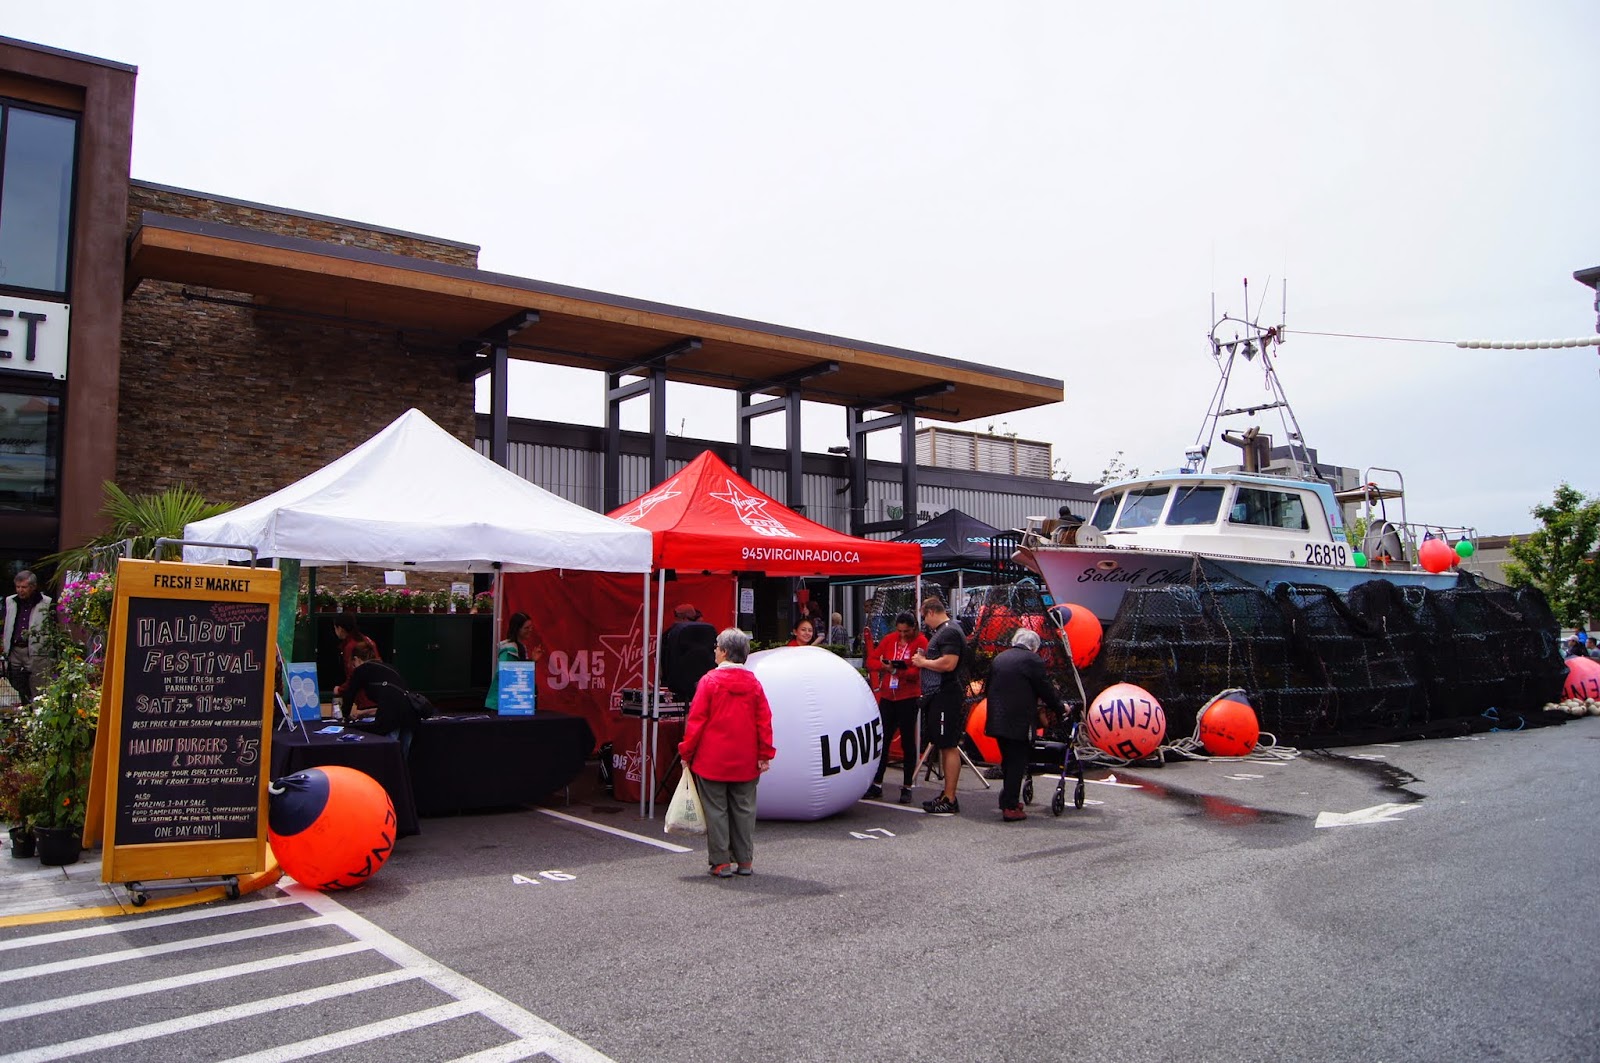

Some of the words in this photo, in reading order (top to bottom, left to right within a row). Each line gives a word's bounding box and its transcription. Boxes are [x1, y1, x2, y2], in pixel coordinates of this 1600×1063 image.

[742, 547, 859, 563] 945VIRGINRADIO.CA
[1305, 543, 1346, 566] 26819
[1077, 567, 1147, 583] Salish
[154, 574, 191, 589] FRESH
[195, 577, 204, 588] ST
[206, 578, 250, 592] MARKET
[164, 676, 172, 684] IN
[175, 676, 188, 684] THE
[191, 675, 215, 684] FRESH
[592, 677, 605, 689] FM
[165, 685, 198, 693] PARKING
[138, 695, 174, 713] SAT
[132, 720, 147, 729] BEST
[150, 720, 168, 728] PRICE
[170, 720, 178, 728] OF
[191, 719, 213, 727] SEASON
[130, 738, 174, 755] HALIBUT
[177, 738, 228, 753] BURGERS
[820, 717, 883, 776] LOVE
[172, 754, 181, 766] &
[186, 754, 224, 766] DRINK
[133, 800, 166, 808] AMAZING
[155, 827, 173, 838] ONE
[176, 826, 191, 836] DAY
[849, 827, 896, 839] 47
[512, 870, 577, 885] 46
